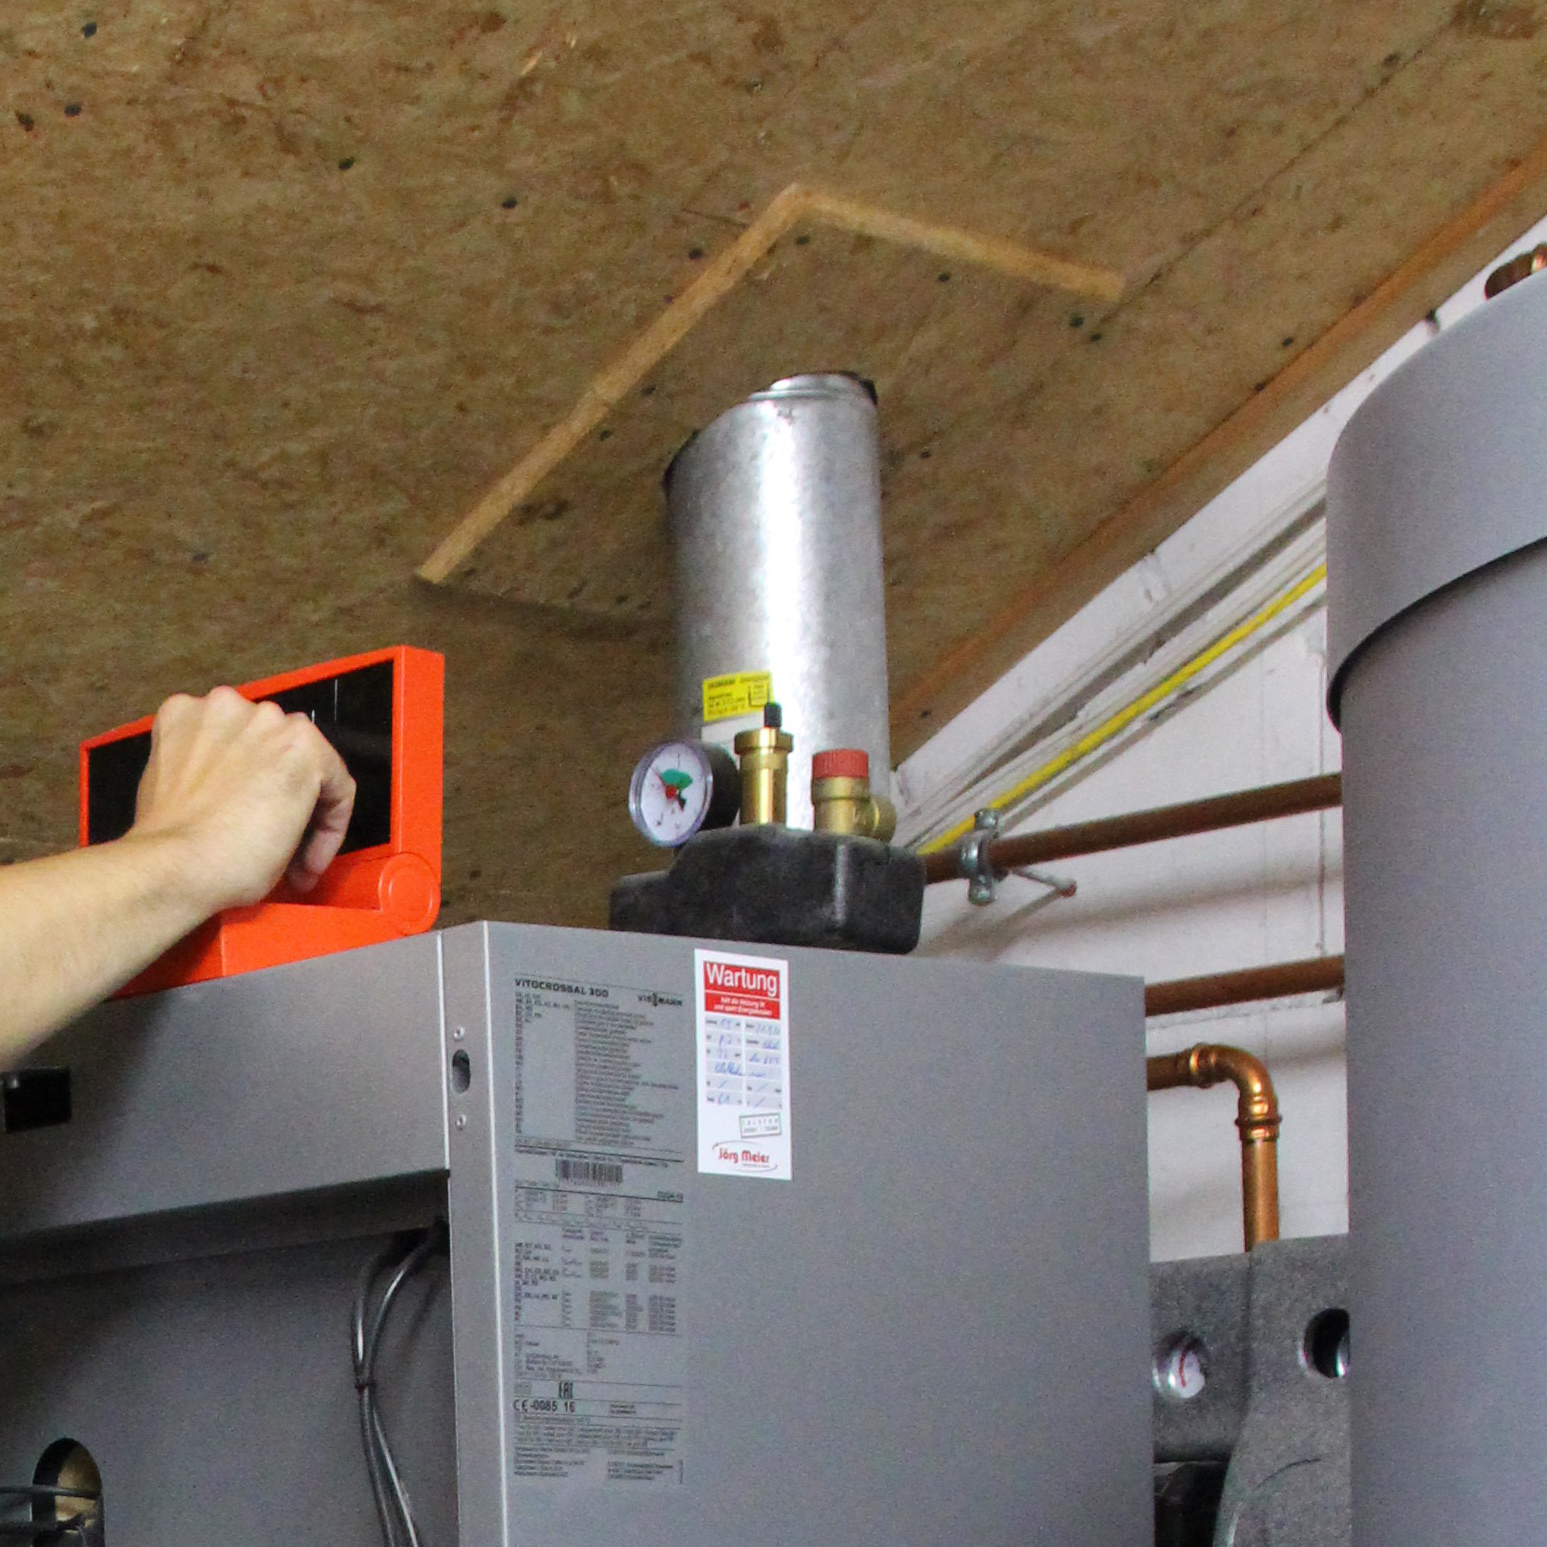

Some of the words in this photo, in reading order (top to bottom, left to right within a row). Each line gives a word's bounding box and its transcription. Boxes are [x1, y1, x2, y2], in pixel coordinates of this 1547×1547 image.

[515, 978, 586, 995] VITOCROSSAL
[706, 963, 777, 998] Wartung
[719, 1147, 739, 1164] Jörg
[741, 1149, 770, 1163] Meier
